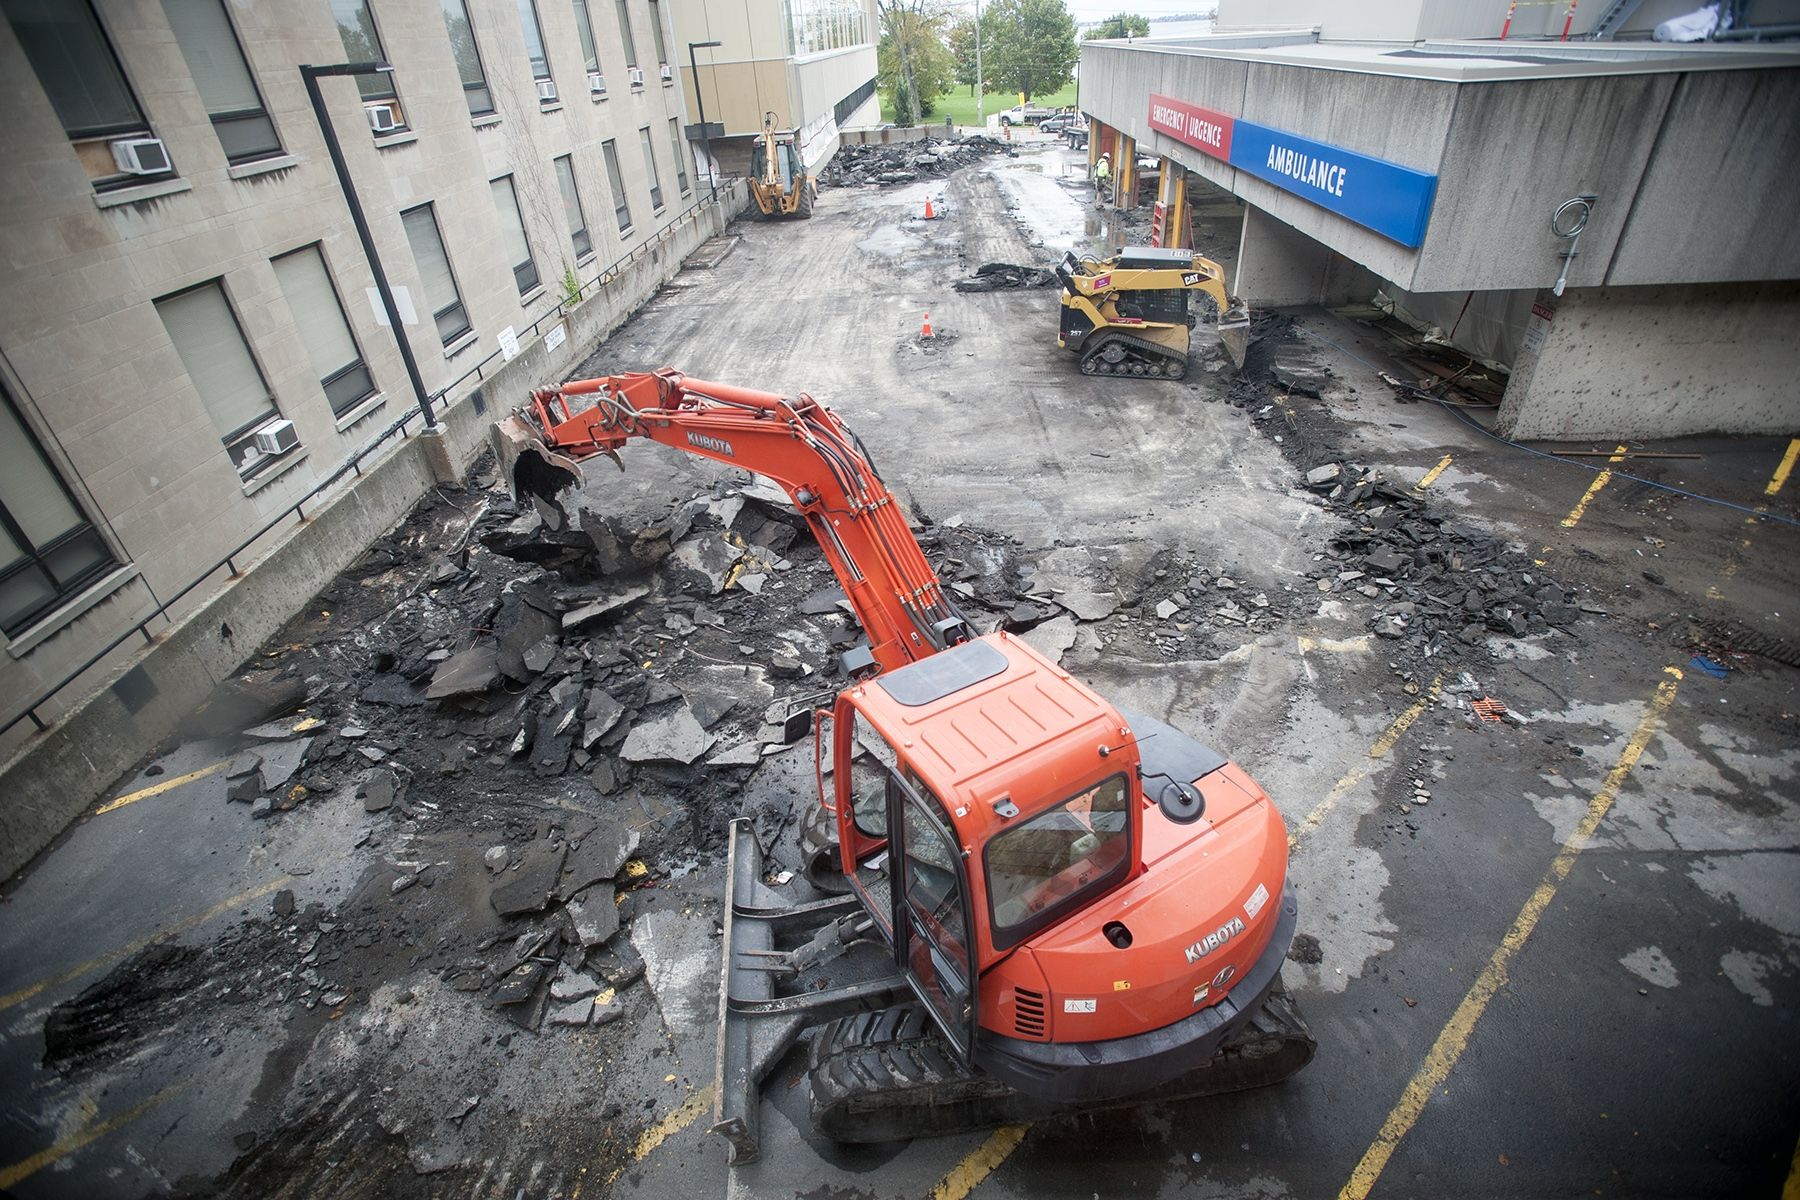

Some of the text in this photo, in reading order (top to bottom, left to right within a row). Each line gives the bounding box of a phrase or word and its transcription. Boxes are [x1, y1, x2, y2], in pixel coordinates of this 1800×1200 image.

[1152, 104, 1185, 131] EMERGENCY
[1189, 116, 1222, 148] URGENCE
[1266, 144, 1347, 197] AMBULANCE
[1184, 273, 1199, 286] CAT
[686, 431, 735, 457] KUBOTA
[1184, 916, 1246, 964] KUBOTA
